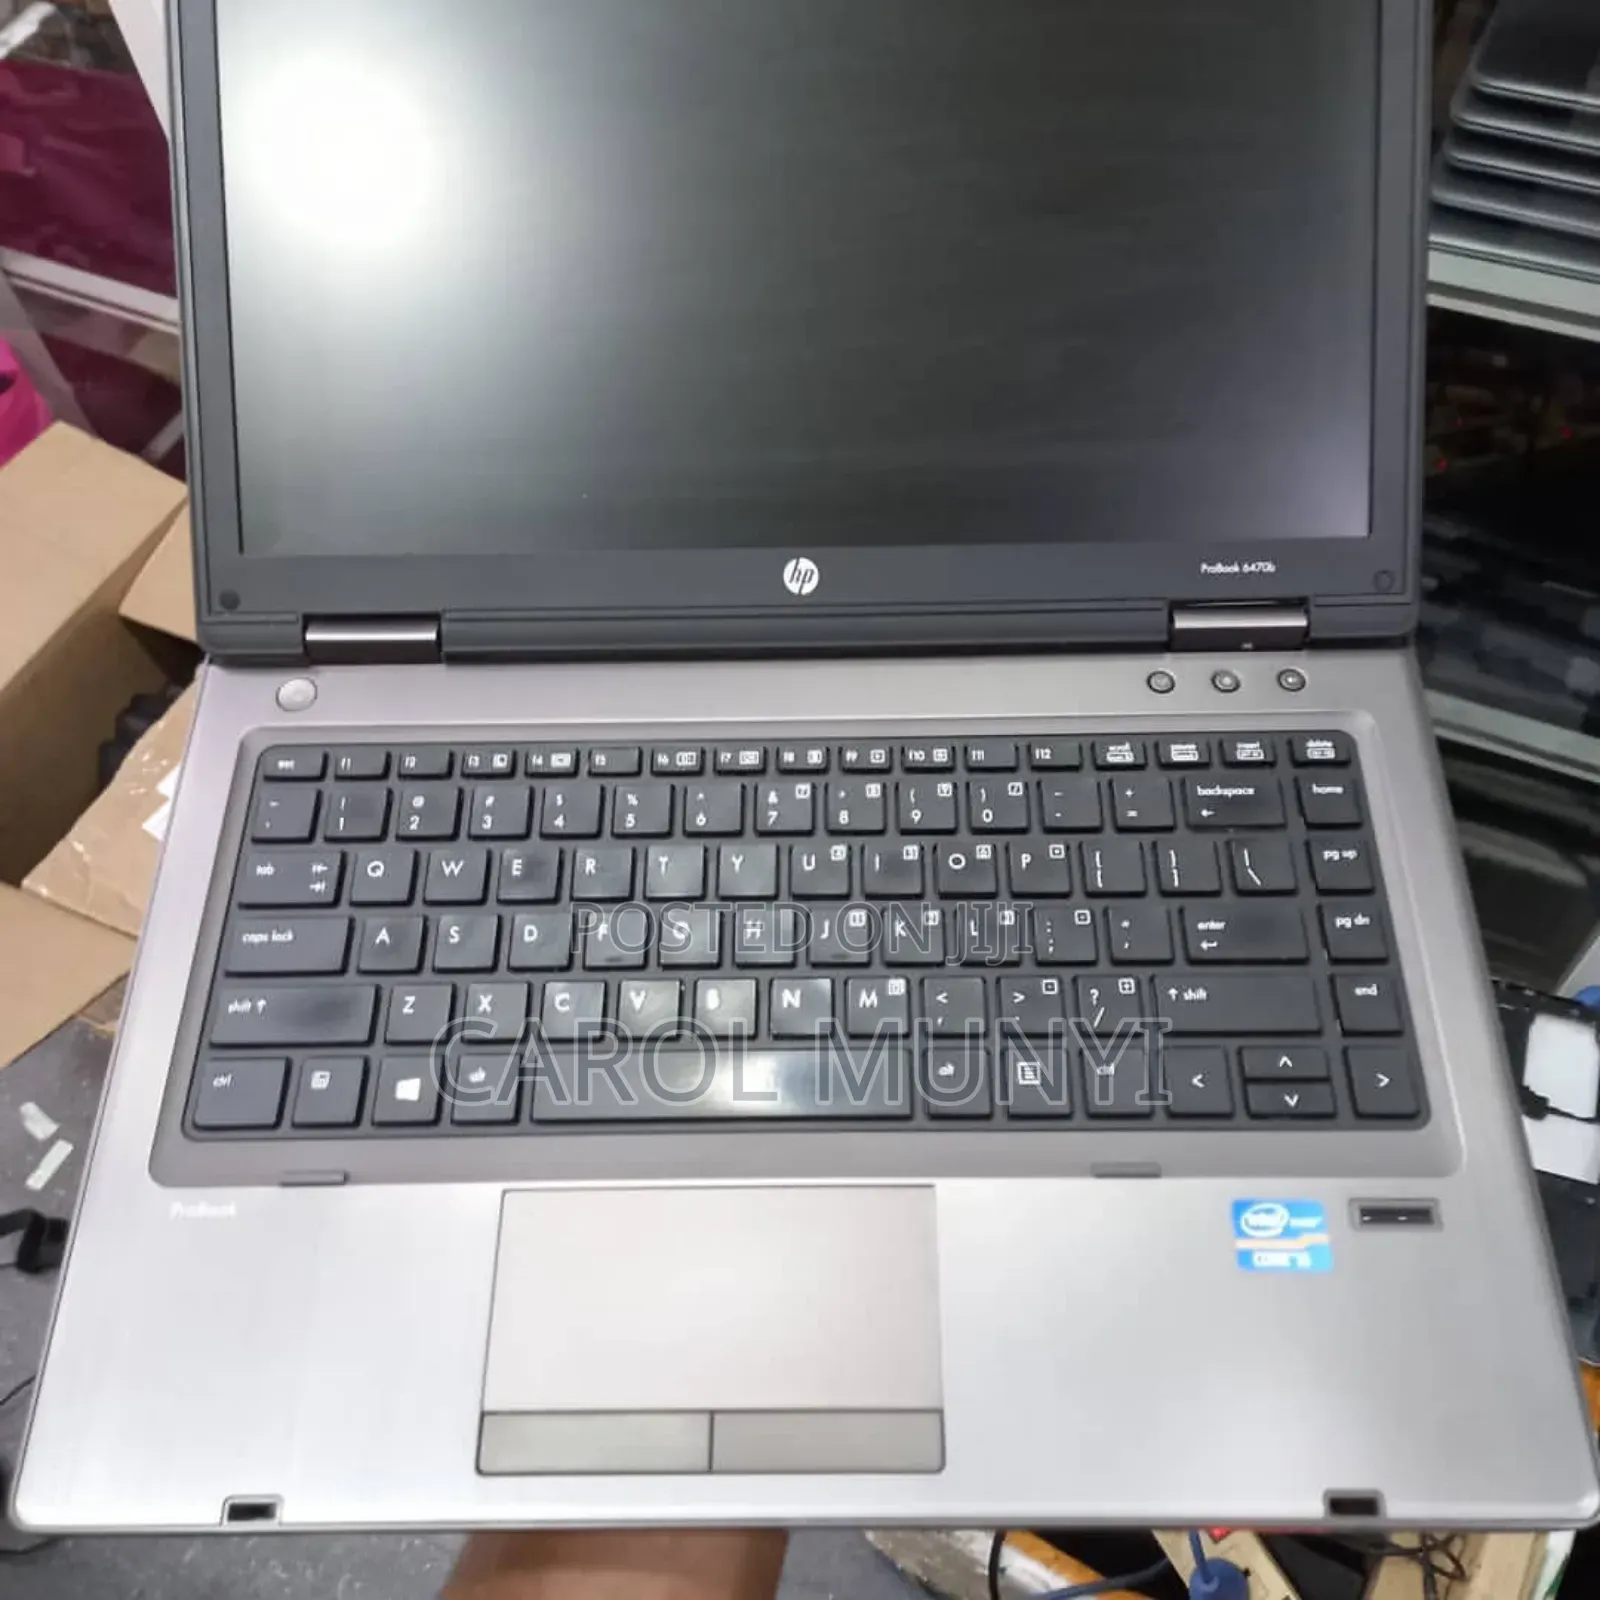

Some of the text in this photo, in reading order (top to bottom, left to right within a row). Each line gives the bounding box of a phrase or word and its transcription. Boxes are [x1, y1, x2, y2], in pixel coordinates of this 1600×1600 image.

[1197, 785, 1254, 797] backspace
[1313, 784, 1343, 794] home
[410, 816, 419, 830] 2
[482, 815, 492, 829] 3
[554, 815, 564, 827] 4
[696, 813, 706, 825] 6
[768, 811, 778, 825] 7
[839, 810, 848, 824] 8
[912, 810, 921, 822] 9
[367, 861, 384, 877] Q
[442, 861, 463, 876] W
[512, 859, 522, 876] E
[586, 858, 595, 874] R
[659, 856, 672, 875] T
[732, 856, 743, 872] Y
[803, 855, 815, 871] U
[524, 925, 538, 942] D
[1198, 921, 1225, 930] enter
[376, 928, 389, 944] A
[450, 926, 459, 943] S
[1184, 988, 1206, 1000] shift
[1355, 984, 1377, 995] end
[403, 996, 415, 1013] Z
[479, 995, 492, 1012] X
[555, 993, 569, 1012] C
[782, 989, 800, 1008] N
[859, 989, 877, 1007] M
